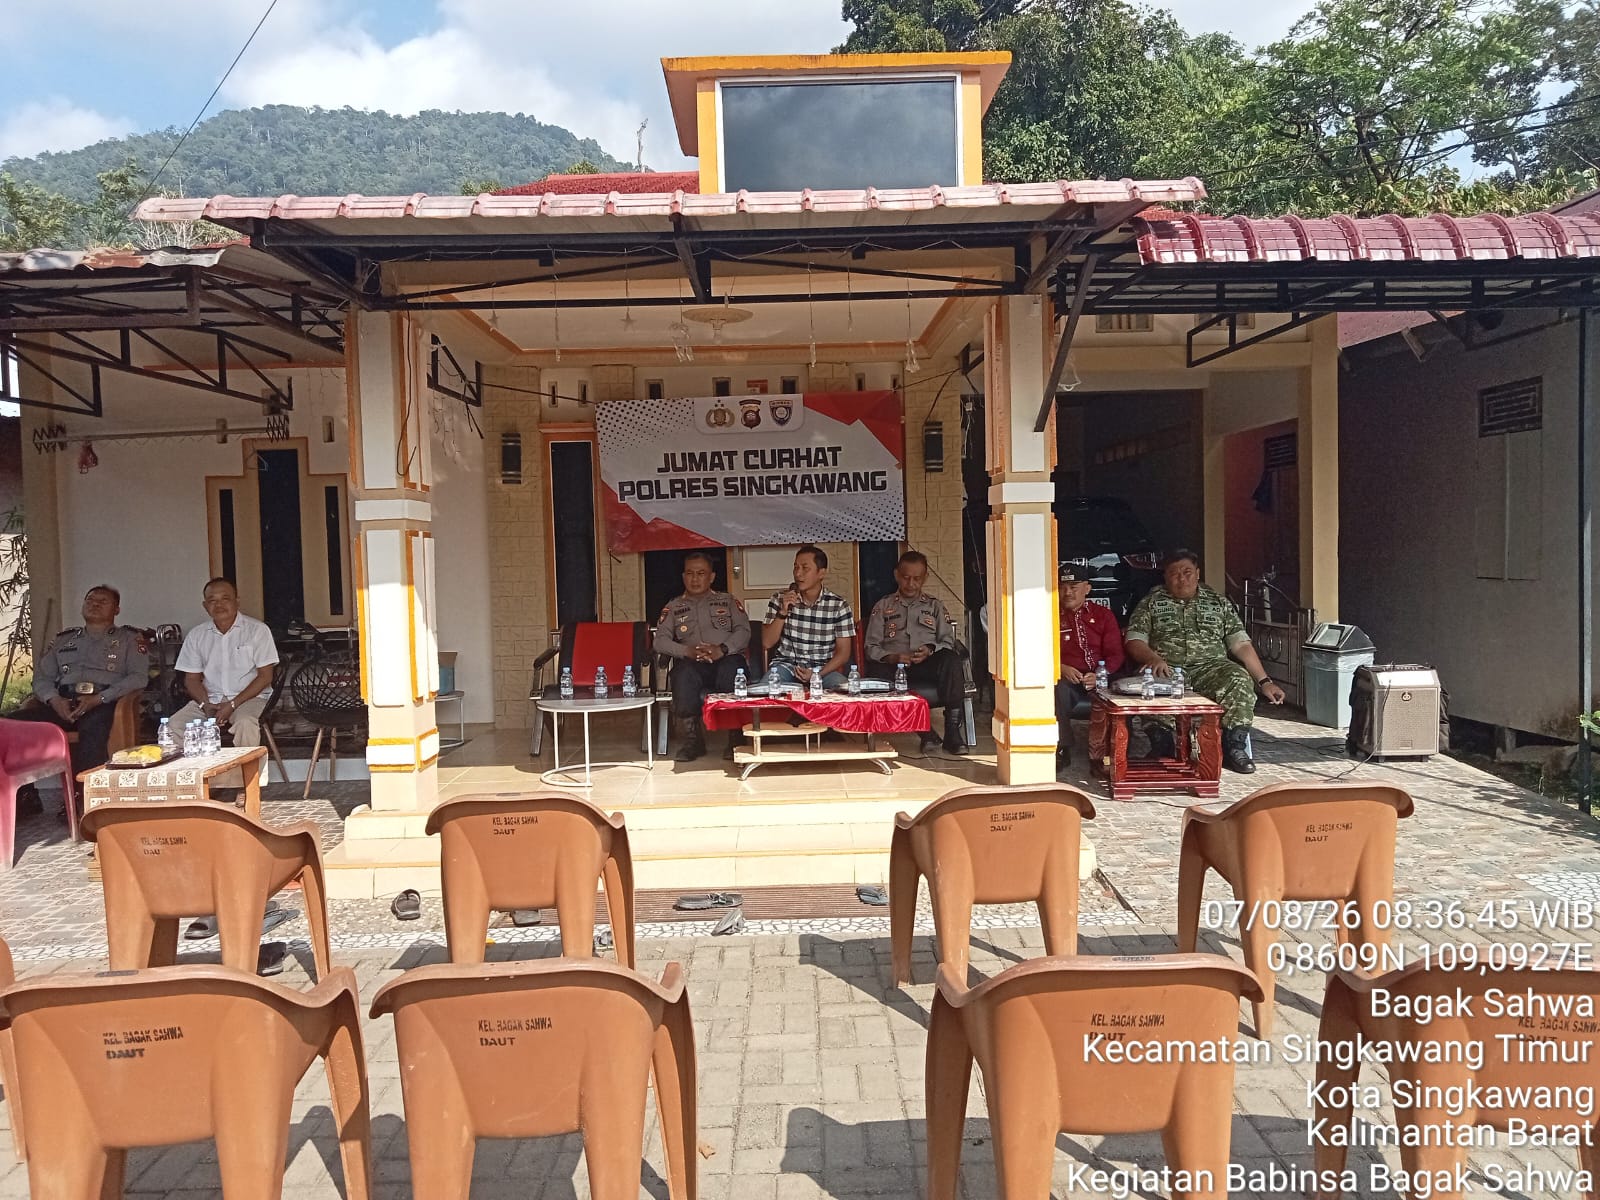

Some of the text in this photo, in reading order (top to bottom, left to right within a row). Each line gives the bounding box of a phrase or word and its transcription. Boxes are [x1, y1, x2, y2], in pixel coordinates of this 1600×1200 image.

[657, 446, 842, 473] JUMAT CURHAT
[618, 470, 887, 501] POLRES SINGKAWANG
[497, 1018, 523, 1032] BAGAK
[525, 1016, 553, 1031] SAHWA
[1110, 1014, 1137, 1028] BAGAK
[1138, 1013, 1165, 1028] SAHWA
[479, 1036, 516, 1046] DAUT
[105, 1047, 145, 1059] DAUT
